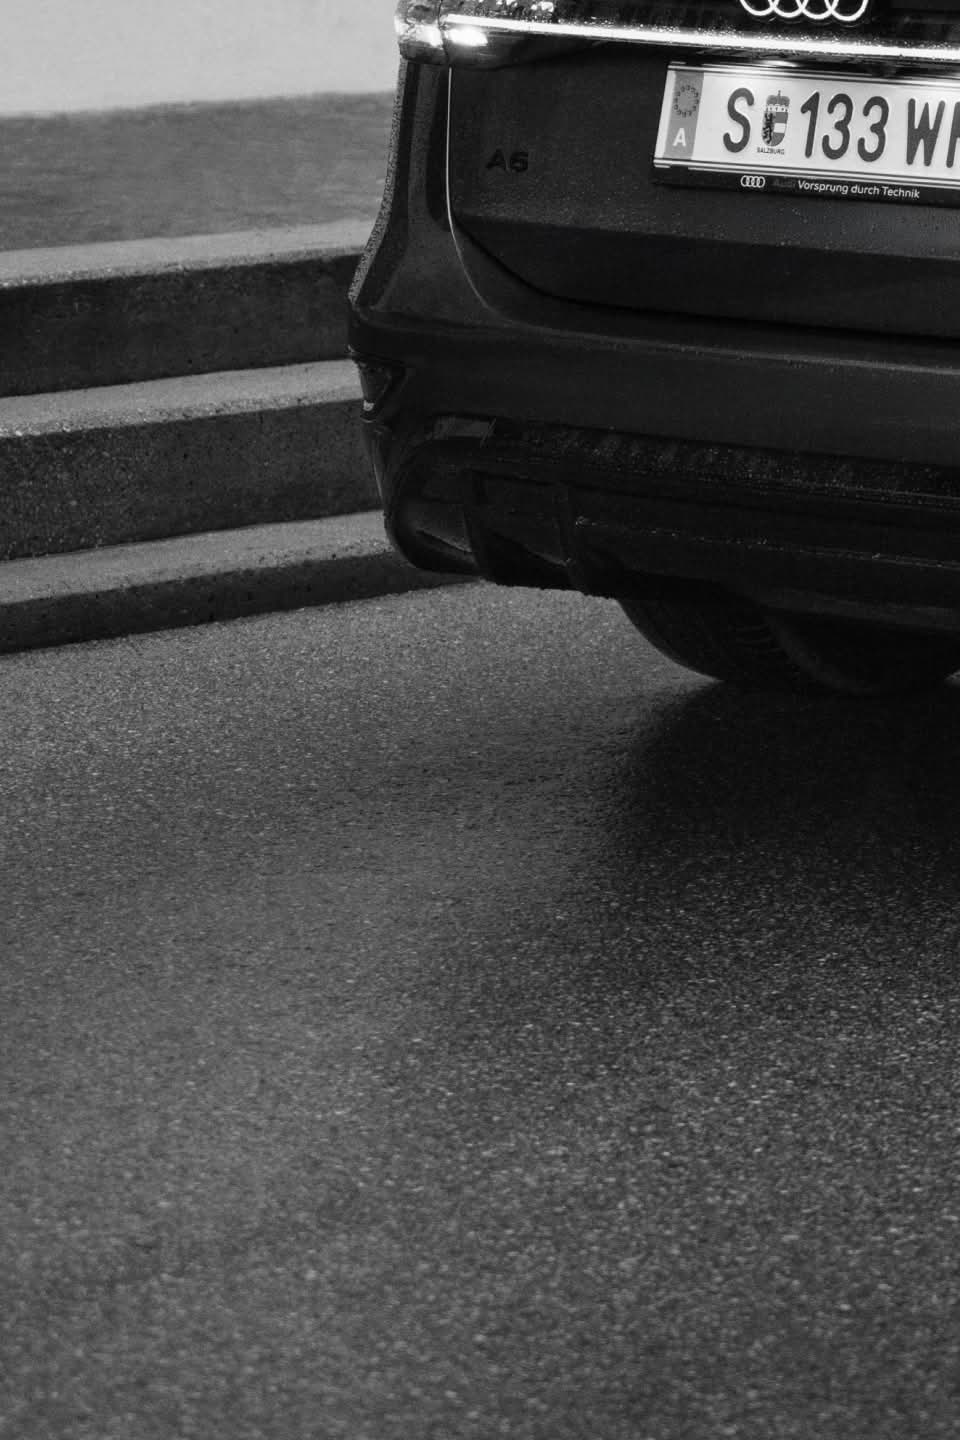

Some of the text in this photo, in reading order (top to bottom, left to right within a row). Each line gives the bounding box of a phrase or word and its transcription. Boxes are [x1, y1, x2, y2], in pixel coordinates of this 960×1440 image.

[722, 87, 755, 154] S
[800, 91, 890, 163] 133
[672, 127, 687, 147] A
[756, 146, 785, 156] SALZBURG
[797, 179, 849, 195] Vorsprung
[850, 183, 881, 196] durch
[882, 185, 921, 199] Technik
